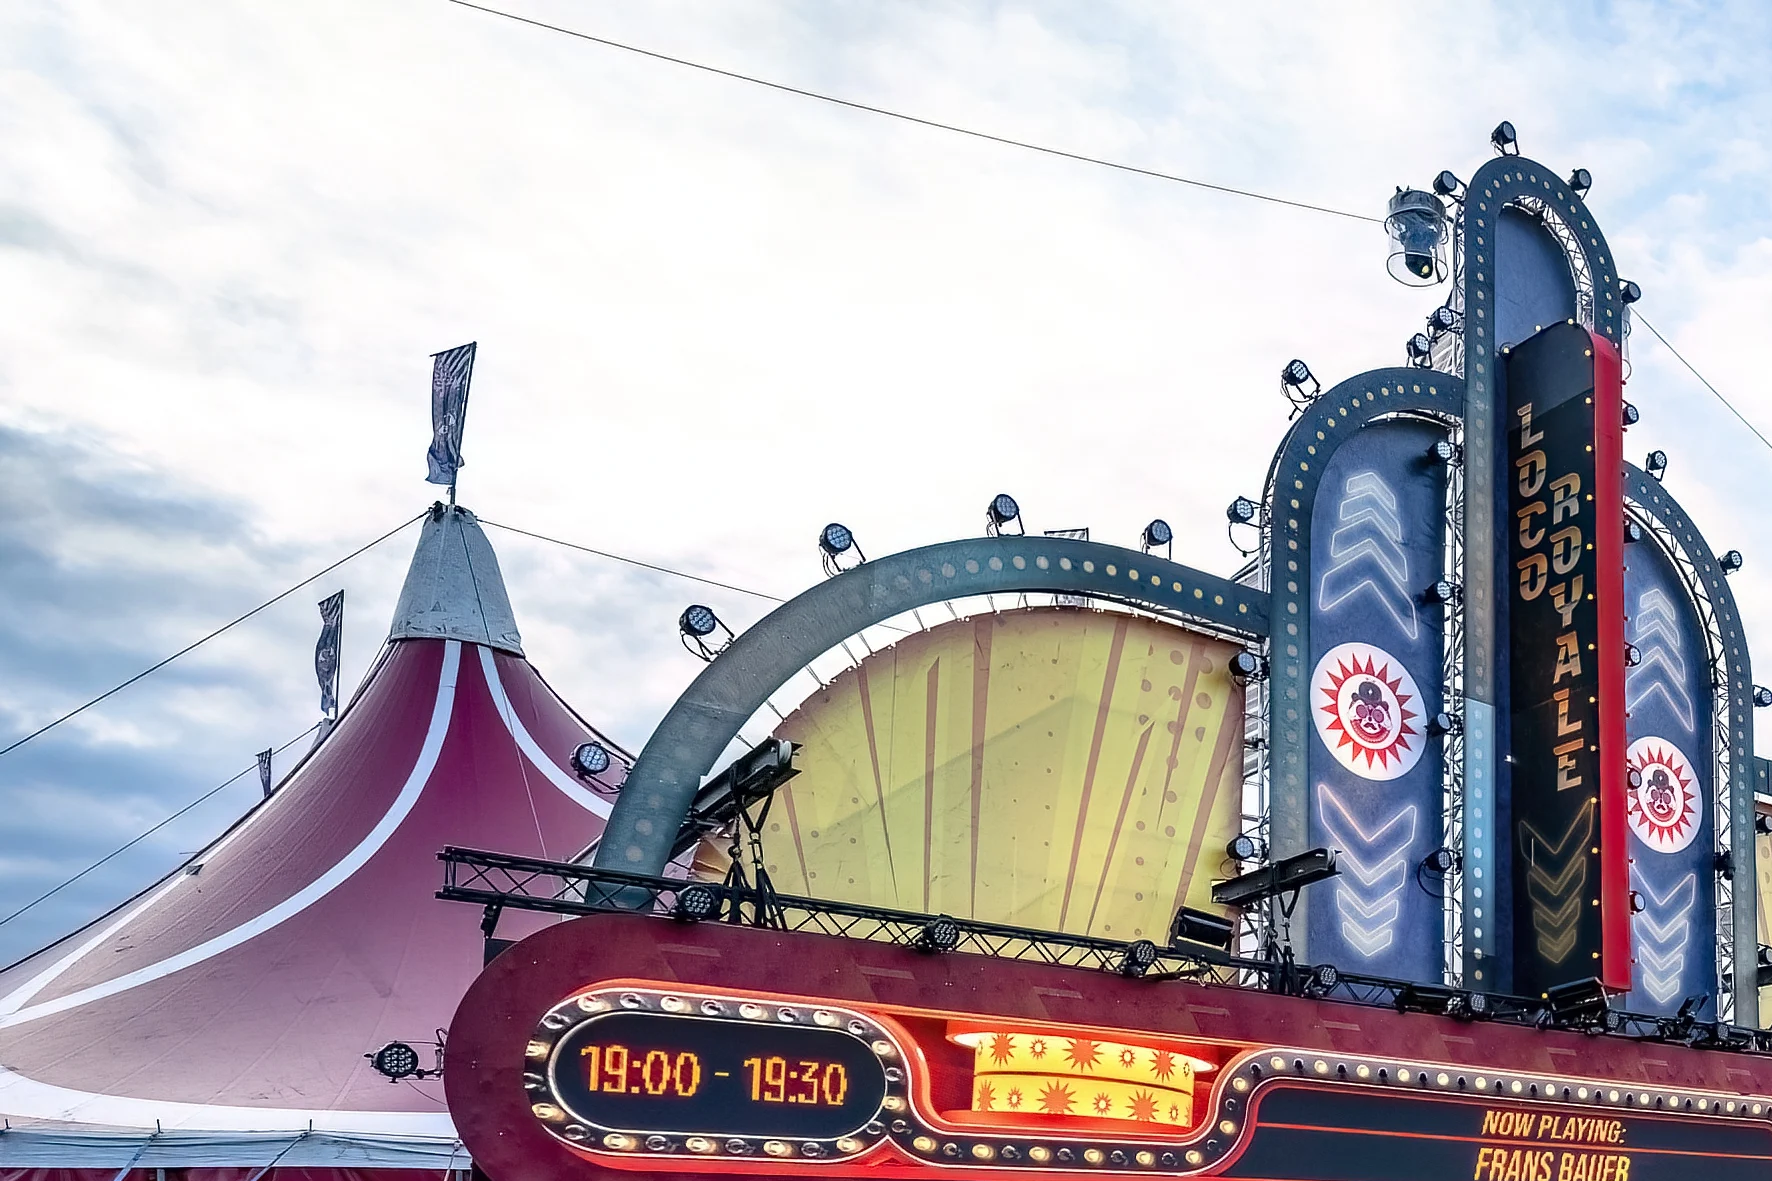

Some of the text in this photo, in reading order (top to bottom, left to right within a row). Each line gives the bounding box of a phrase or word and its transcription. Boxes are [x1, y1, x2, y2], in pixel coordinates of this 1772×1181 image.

[1516, 402, 1547, 601] LOCO
[1549, 472, 1584, 791] ROYALE
[581, 1045, 700, 1097] 19:00
[744, 1056, 847, 1106] 19:30
[1481, 1110, 1627, 1144] NOW PLAYING:
